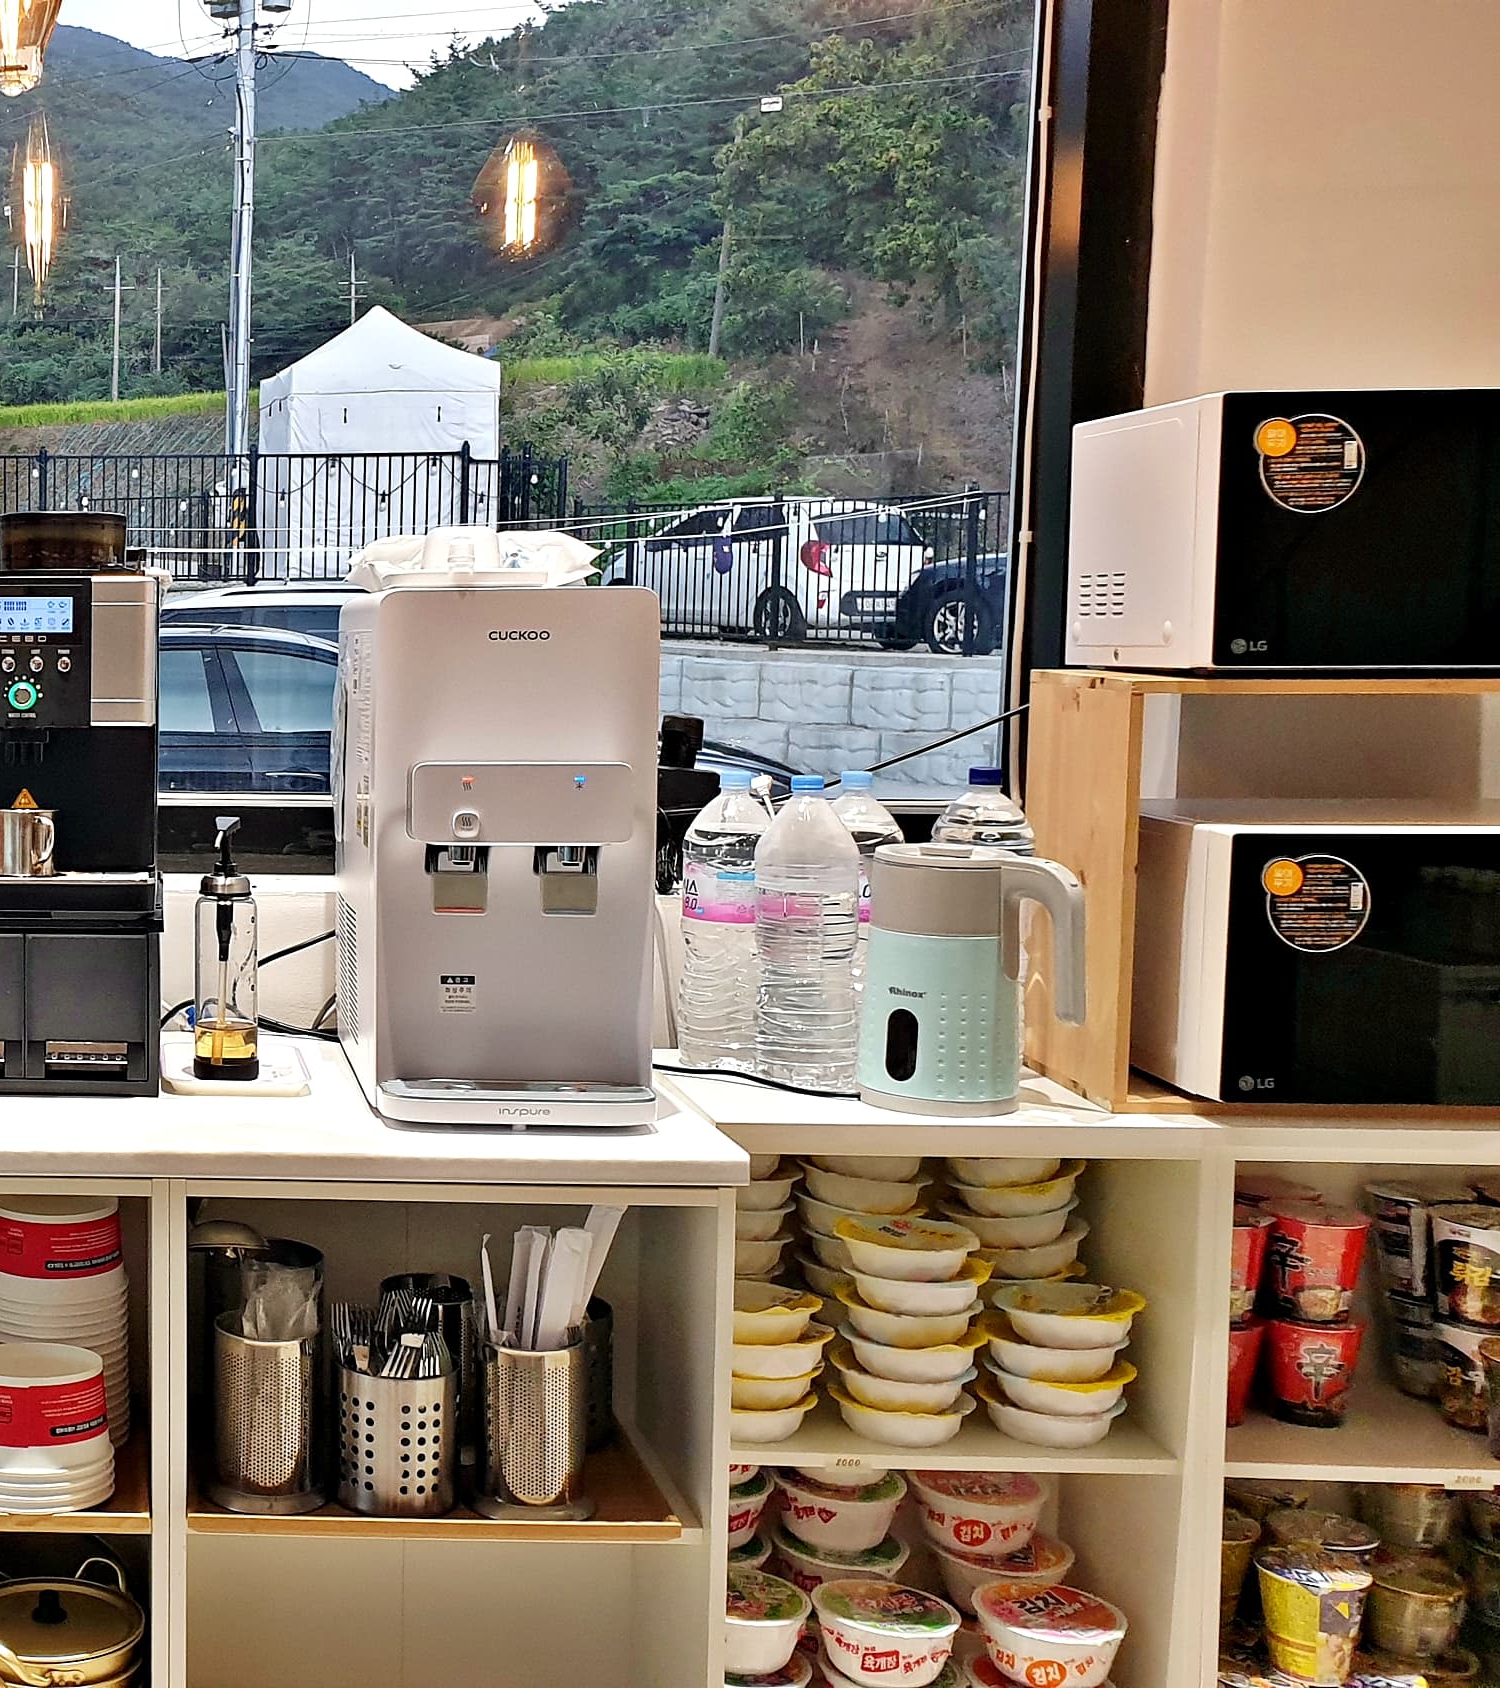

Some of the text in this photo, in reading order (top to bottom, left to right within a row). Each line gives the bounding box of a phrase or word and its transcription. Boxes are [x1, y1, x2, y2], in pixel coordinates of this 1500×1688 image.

[487, 629, 551, 642] CUCKOO
[1249, 640, 1268, 652] LG
[1256, 1077, 1275, 1089] LG
[498, 1107, 551, 1117] inspure
[862, 1654, 899, 1672] 육개장
[1031, 1663, 1062, 1686] 김치
